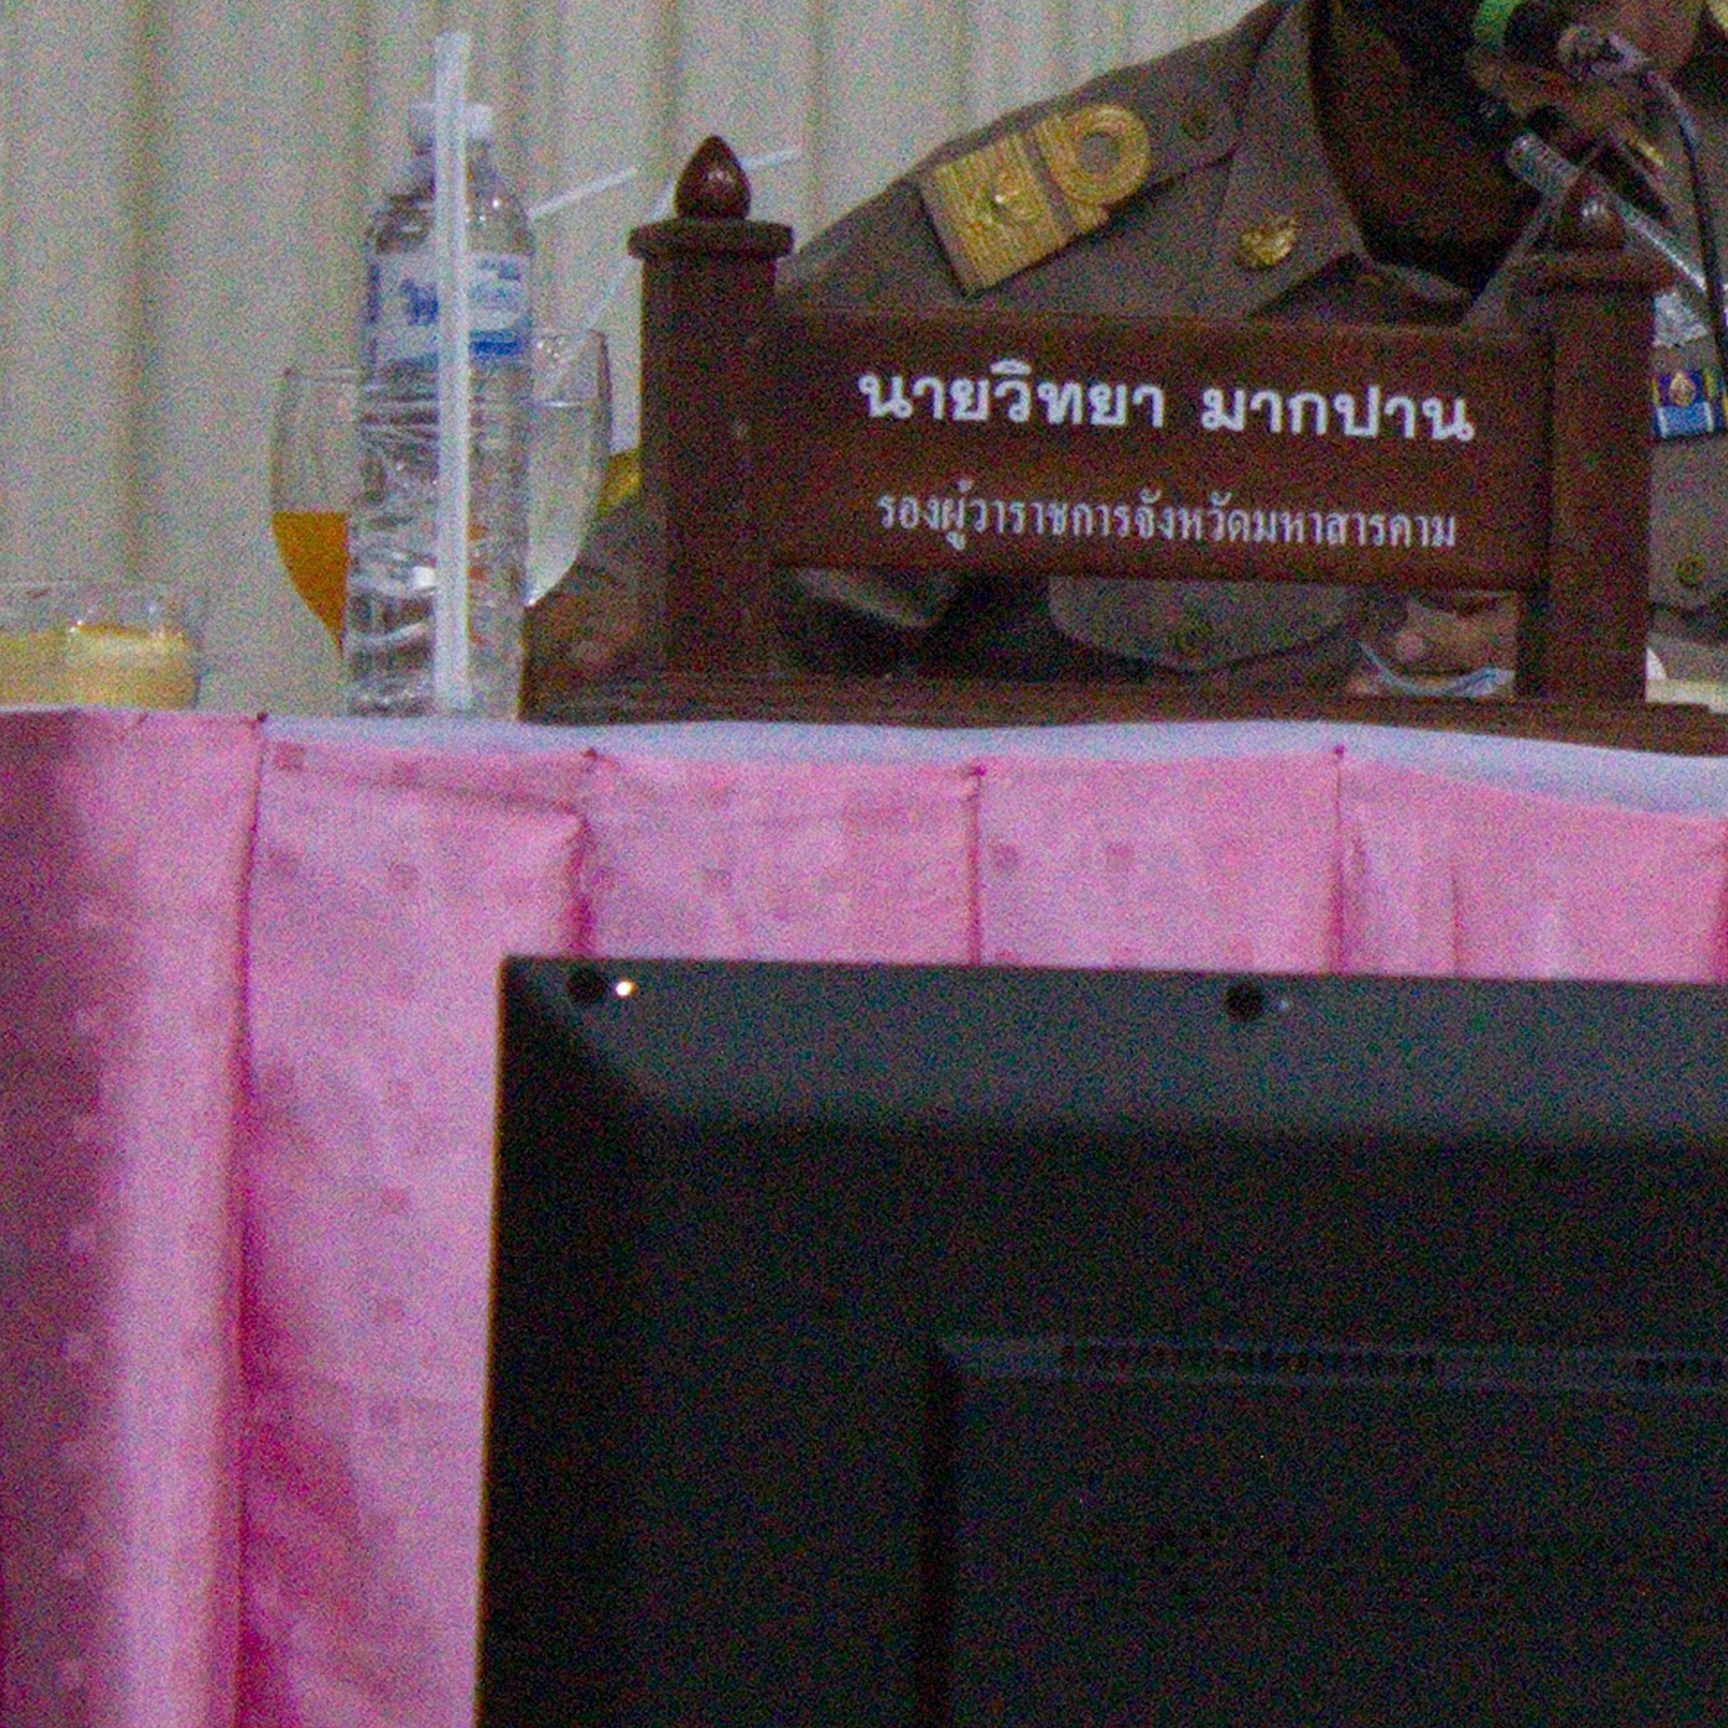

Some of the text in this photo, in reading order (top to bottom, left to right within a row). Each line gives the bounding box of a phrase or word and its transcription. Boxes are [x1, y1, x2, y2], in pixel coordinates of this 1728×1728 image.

[858, 357, 1475, 442] นายวิทยา มากปาน
